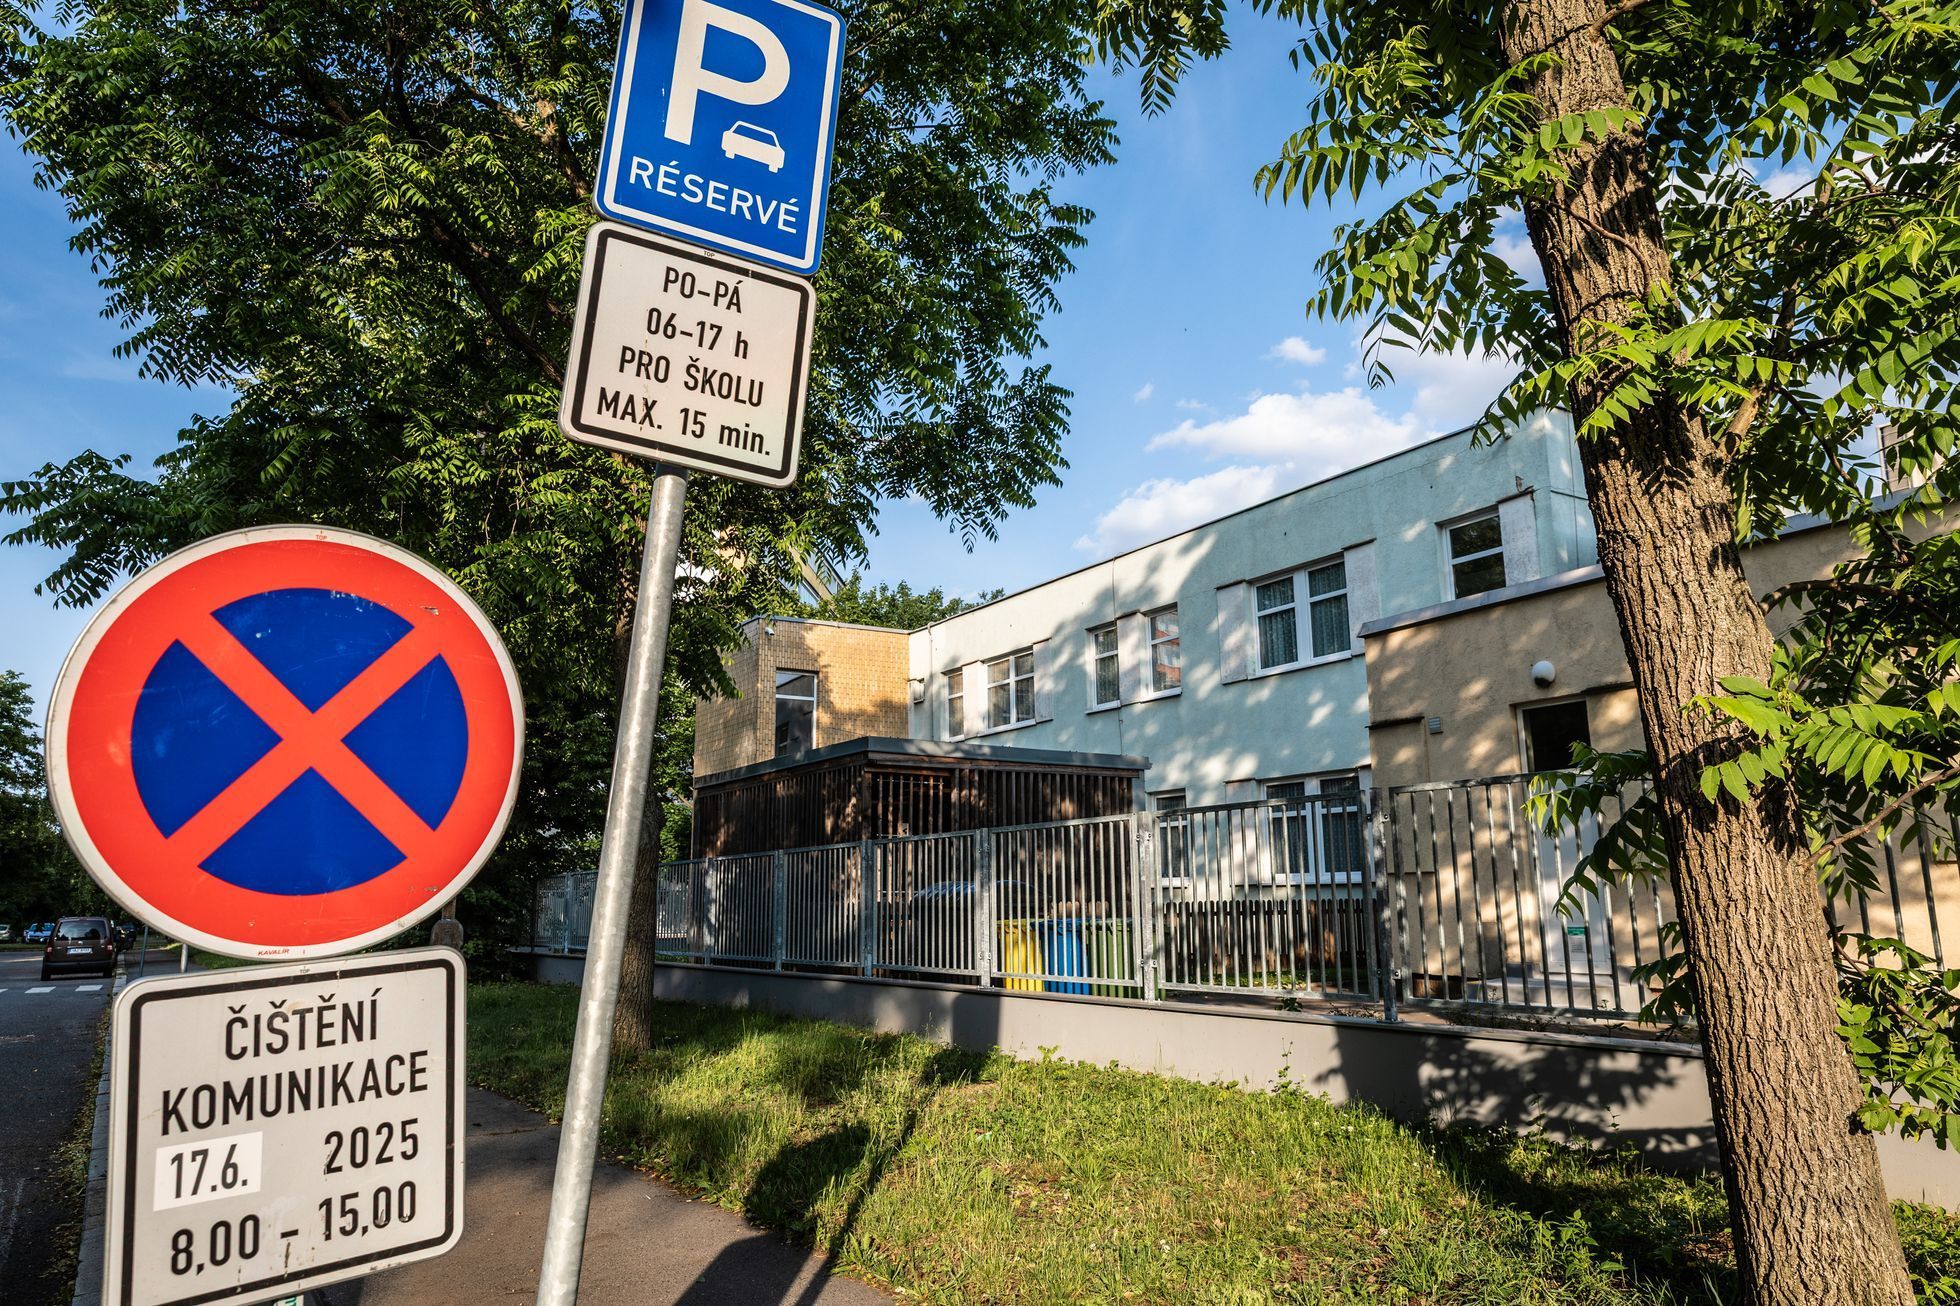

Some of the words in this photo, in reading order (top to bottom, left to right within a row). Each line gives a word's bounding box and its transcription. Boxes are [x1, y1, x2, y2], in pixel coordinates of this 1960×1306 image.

[664, 0, 790, 146] P
[629, 155, 800, 234] RÉSERVÉ
[663, 266, 744, 313] PO-PÁ
[703, 250, 715, 258] TOP
[646, 307, 723, 351] 06-17
[734, 330, 749, 359] h
[619, 345, 670, 384] PRO
[683, 355, 764, 407] ŠKOLU
[597, 386, 663, 430] MAX.
[680, 407, 707, 439] 15
[718, 422, 771, 456] min.
[225, 987, 383, 1060] ČIŠTĚNÍ
[161, 1050, 429, 1136] KOMUNIKACE
[170, 1143, 248, 1199] 17.6.
[324, 1118, 419, 1175] 2025
[170, 1214, 260, 1276] 8,00
[318, 1180, 417, 1241] 15,00
